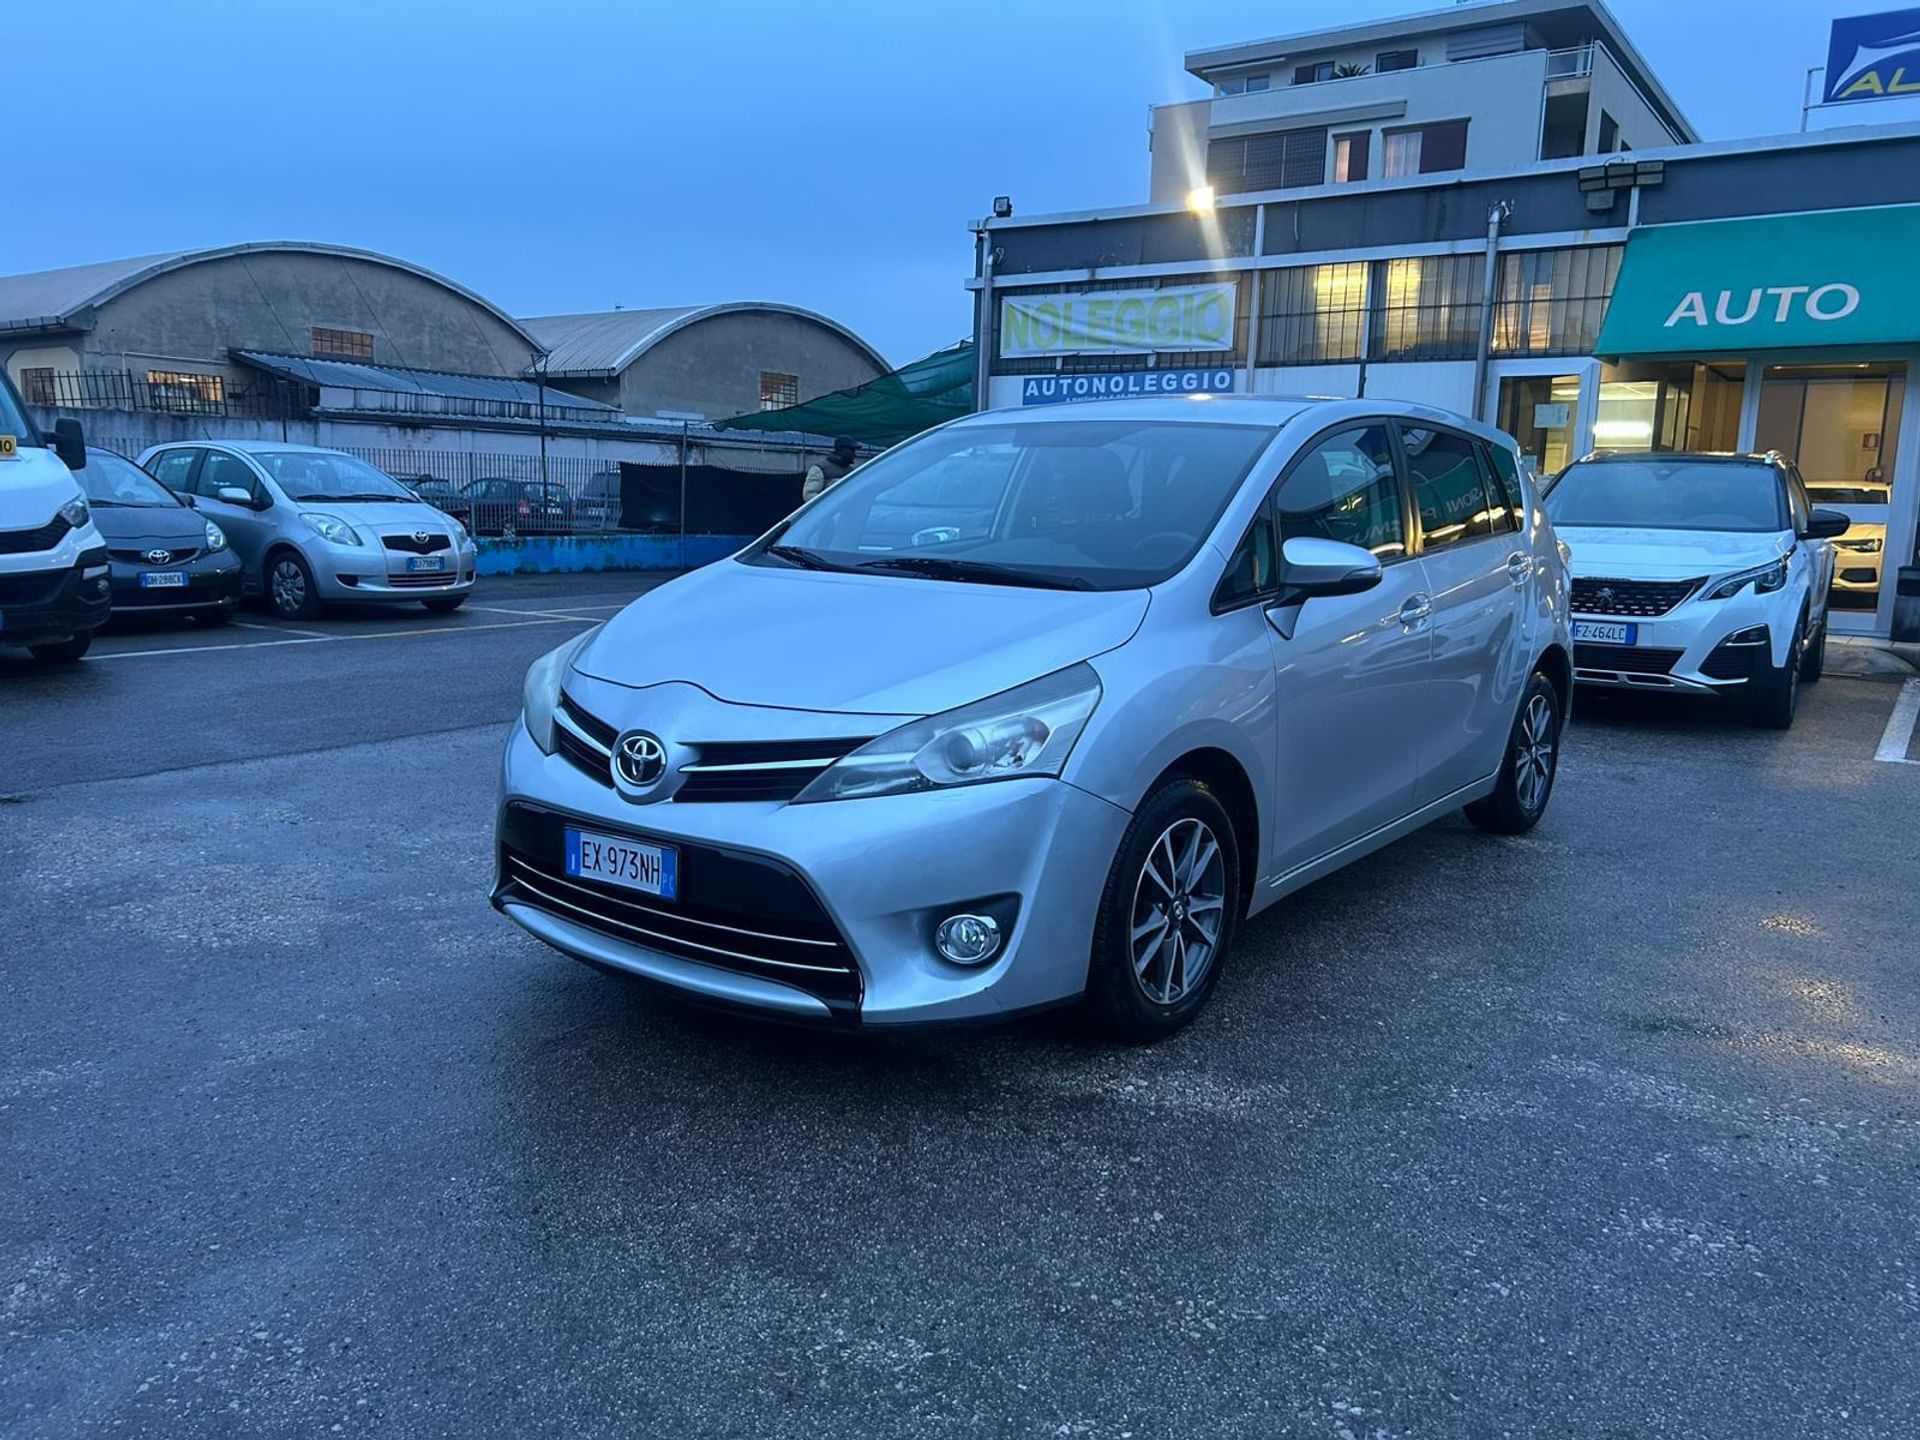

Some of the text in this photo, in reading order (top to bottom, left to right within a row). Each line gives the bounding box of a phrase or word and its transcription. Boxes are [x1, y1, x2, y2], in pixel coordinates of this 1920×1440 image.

[1005, 291, 1229, 350] NOLEGGIO
[1663, 283, 1860, 328] AUTO
[1025, 371, 1230, 396] AUTONOLEGGIO
